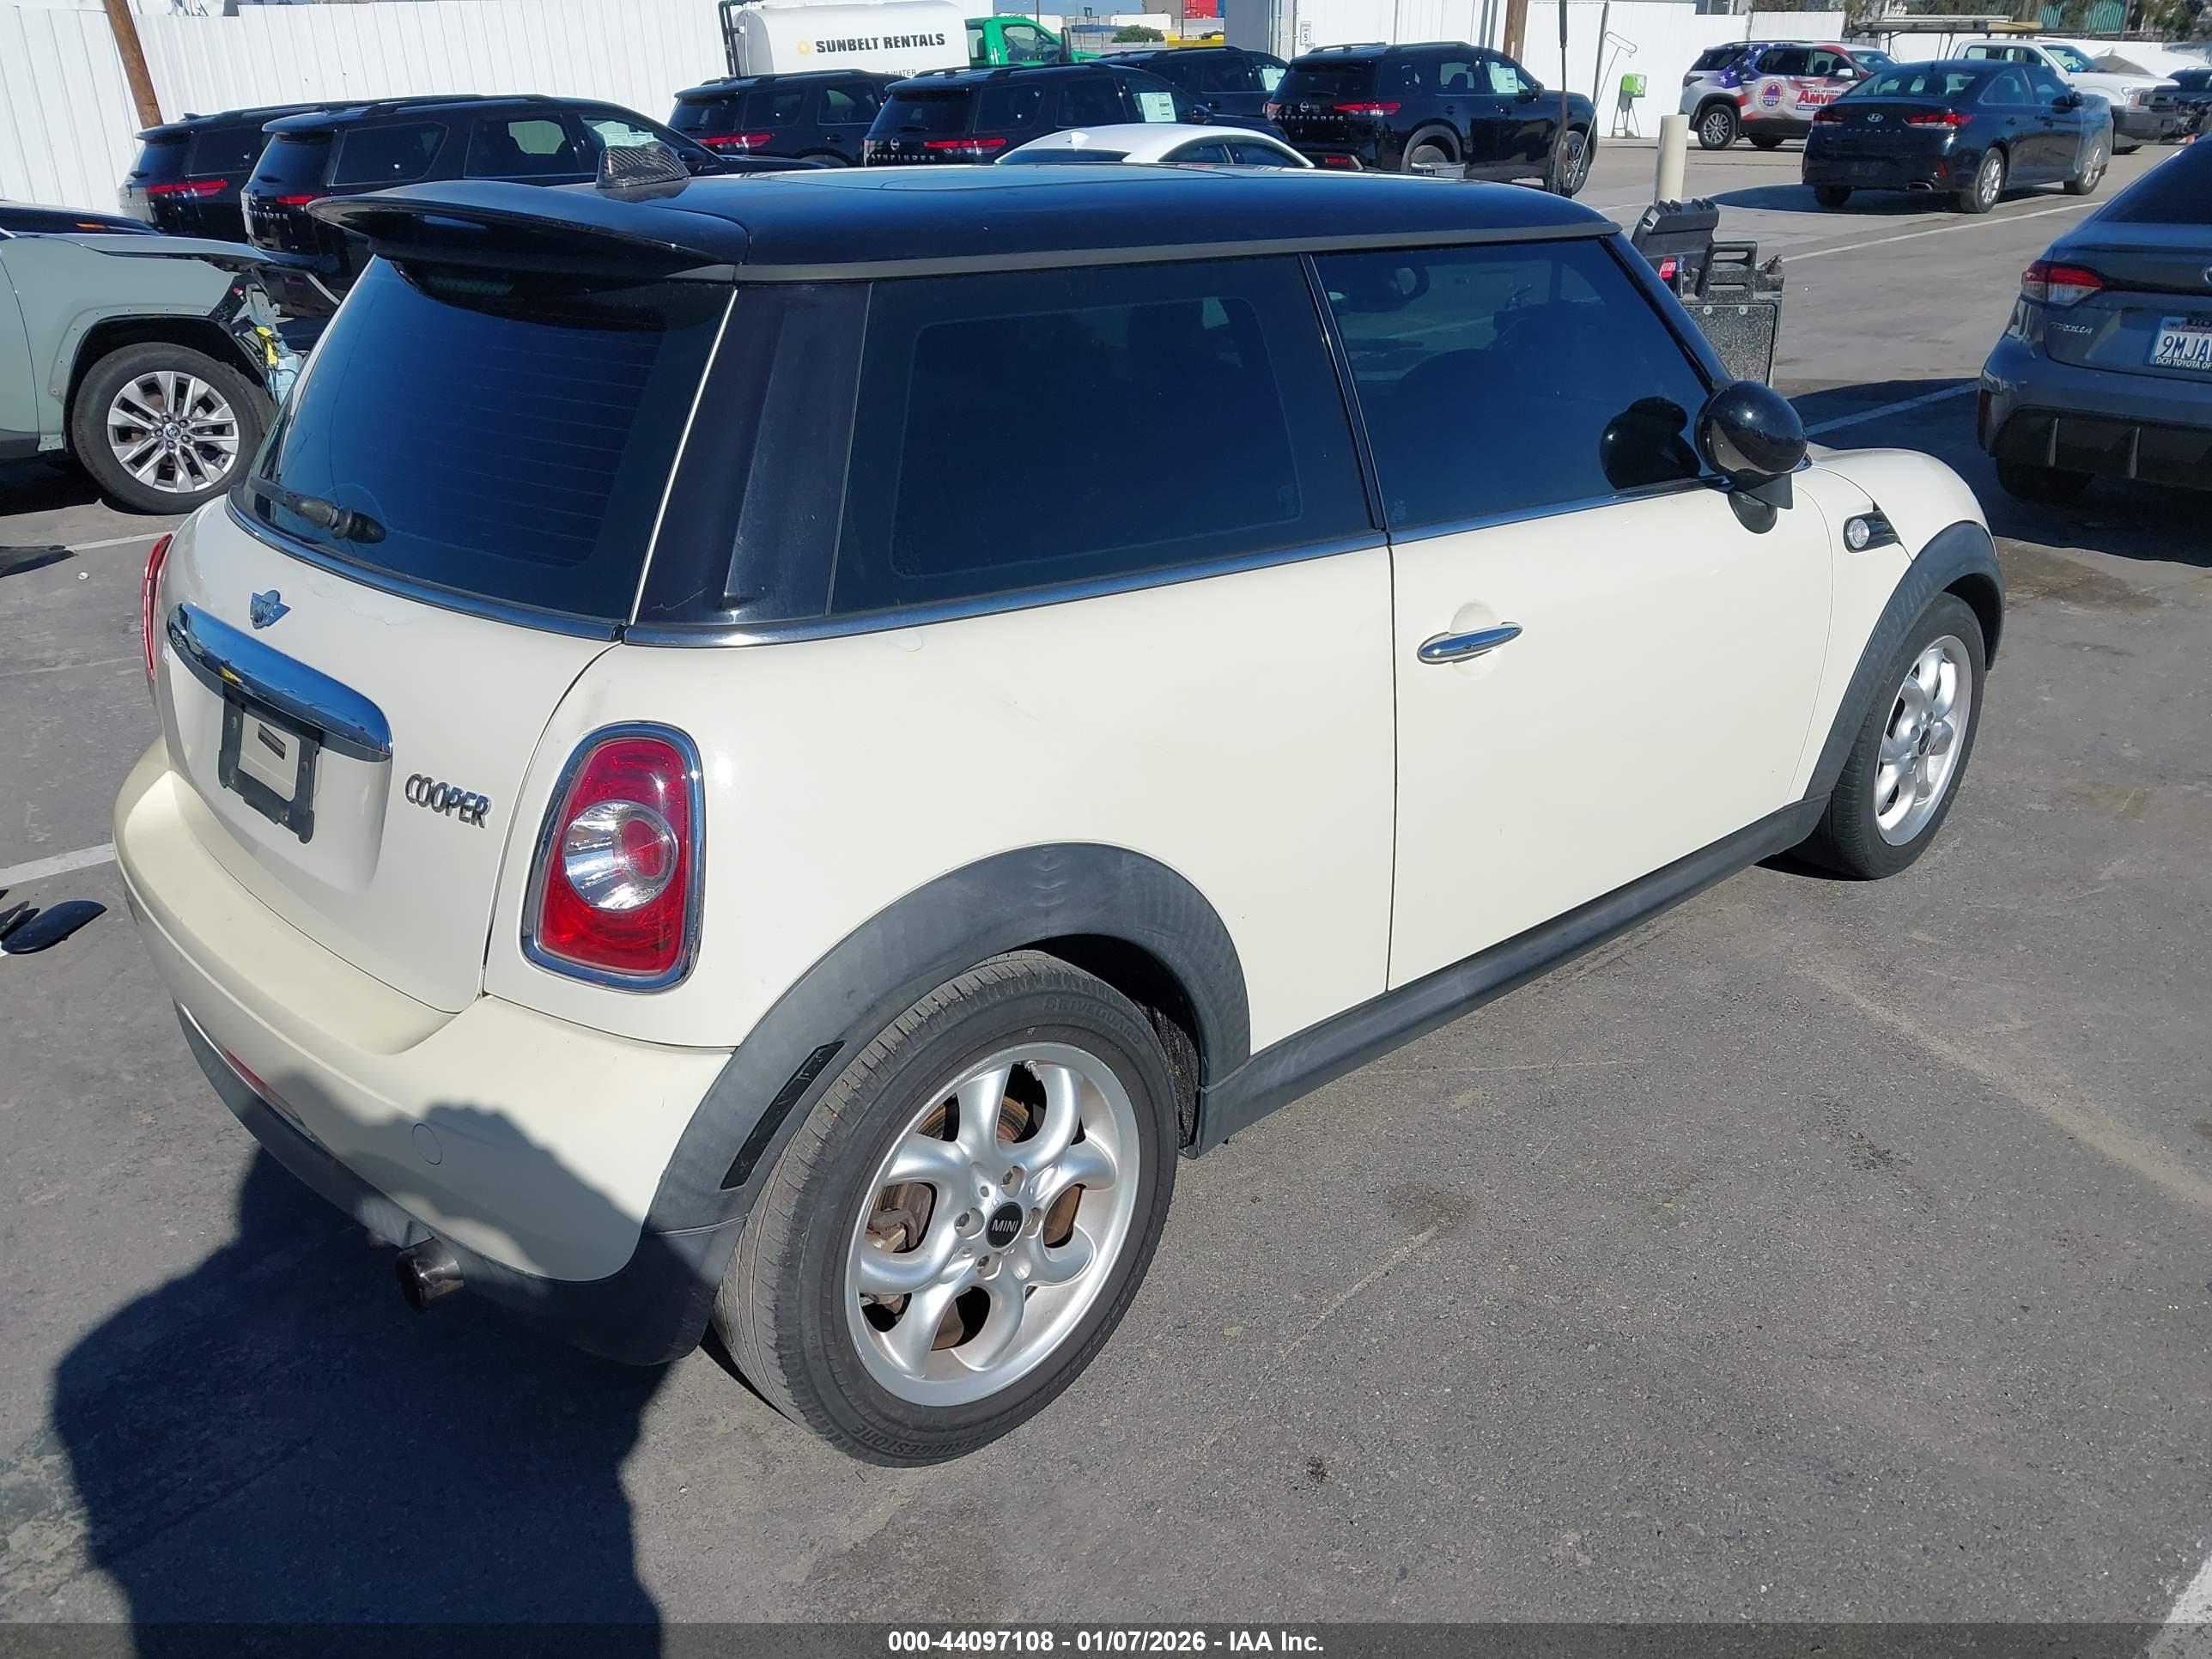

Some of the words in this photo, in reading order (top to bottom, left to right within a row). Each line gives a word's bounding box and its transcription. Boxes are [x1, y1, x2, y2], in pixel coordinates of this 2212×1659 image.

[816, 38, 878, 53] SUNBELT
[883, 33, 945, 50] RENTALS
[2158, 336, 2212, 360] 9MJA
[2172, 359, 2201, 368] TOYOTA
[405, 774, 490, 828] COOPER
[991, 1219, 1019, 1232] MINI
